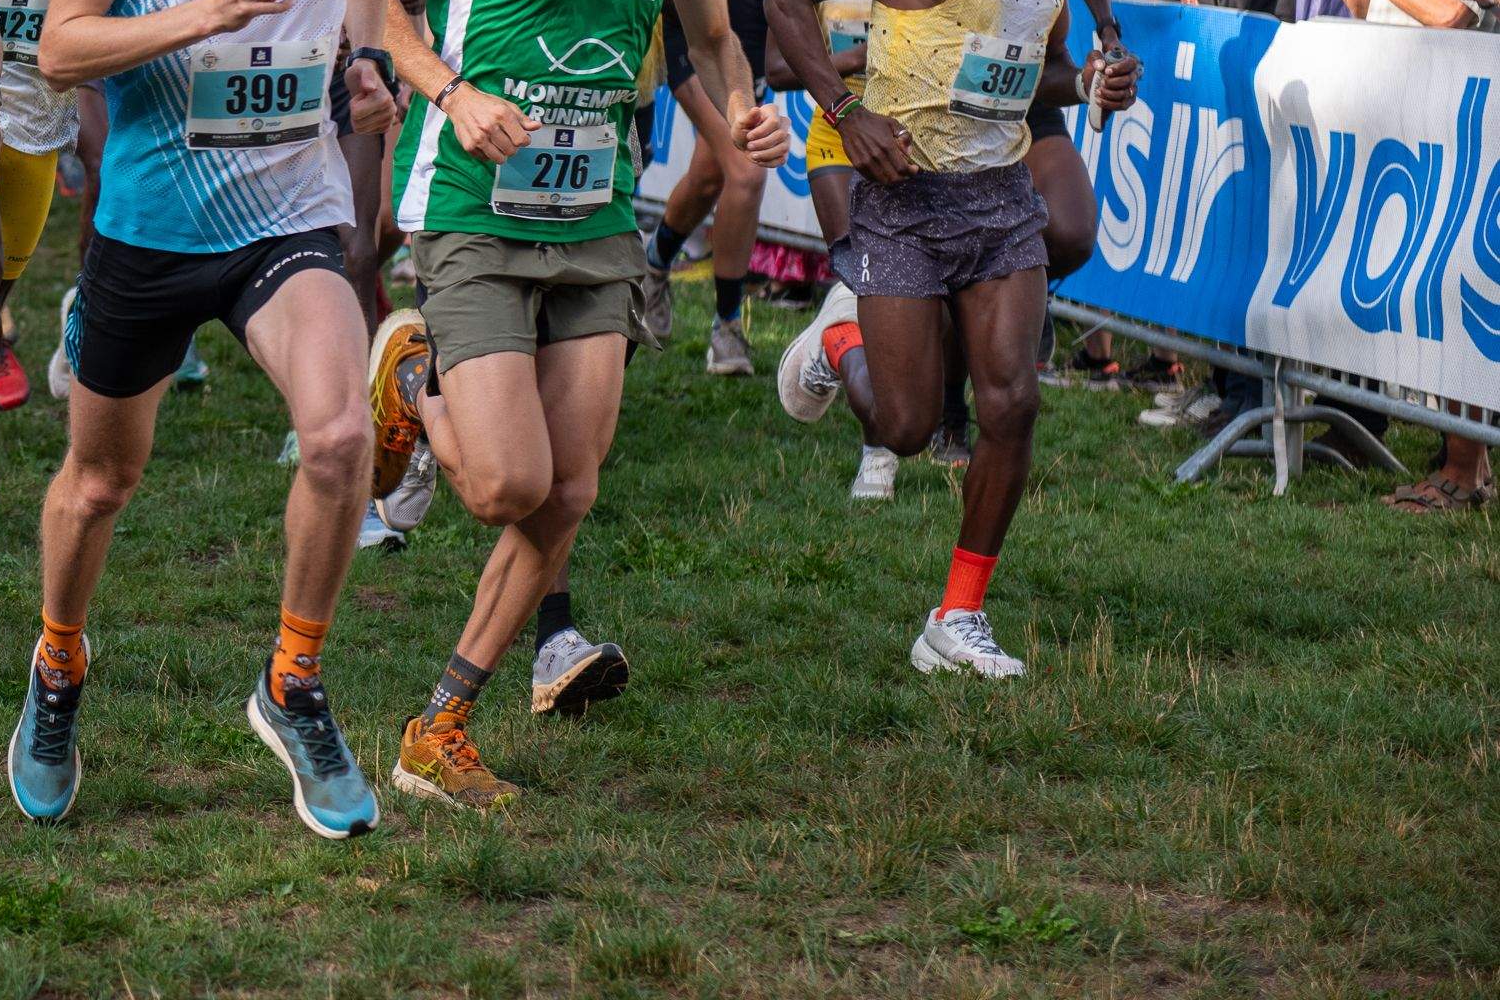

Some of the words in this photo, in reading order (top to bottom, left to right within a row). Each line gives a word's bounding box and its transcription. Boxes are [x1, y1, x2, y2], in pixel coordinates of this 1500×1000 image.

[226, 73, 298, 115] 399
[504, 77, 638, 109] MONTEMURO
[981, 63, 1026, 96] 397
[531, 153, 590, 189] 276
